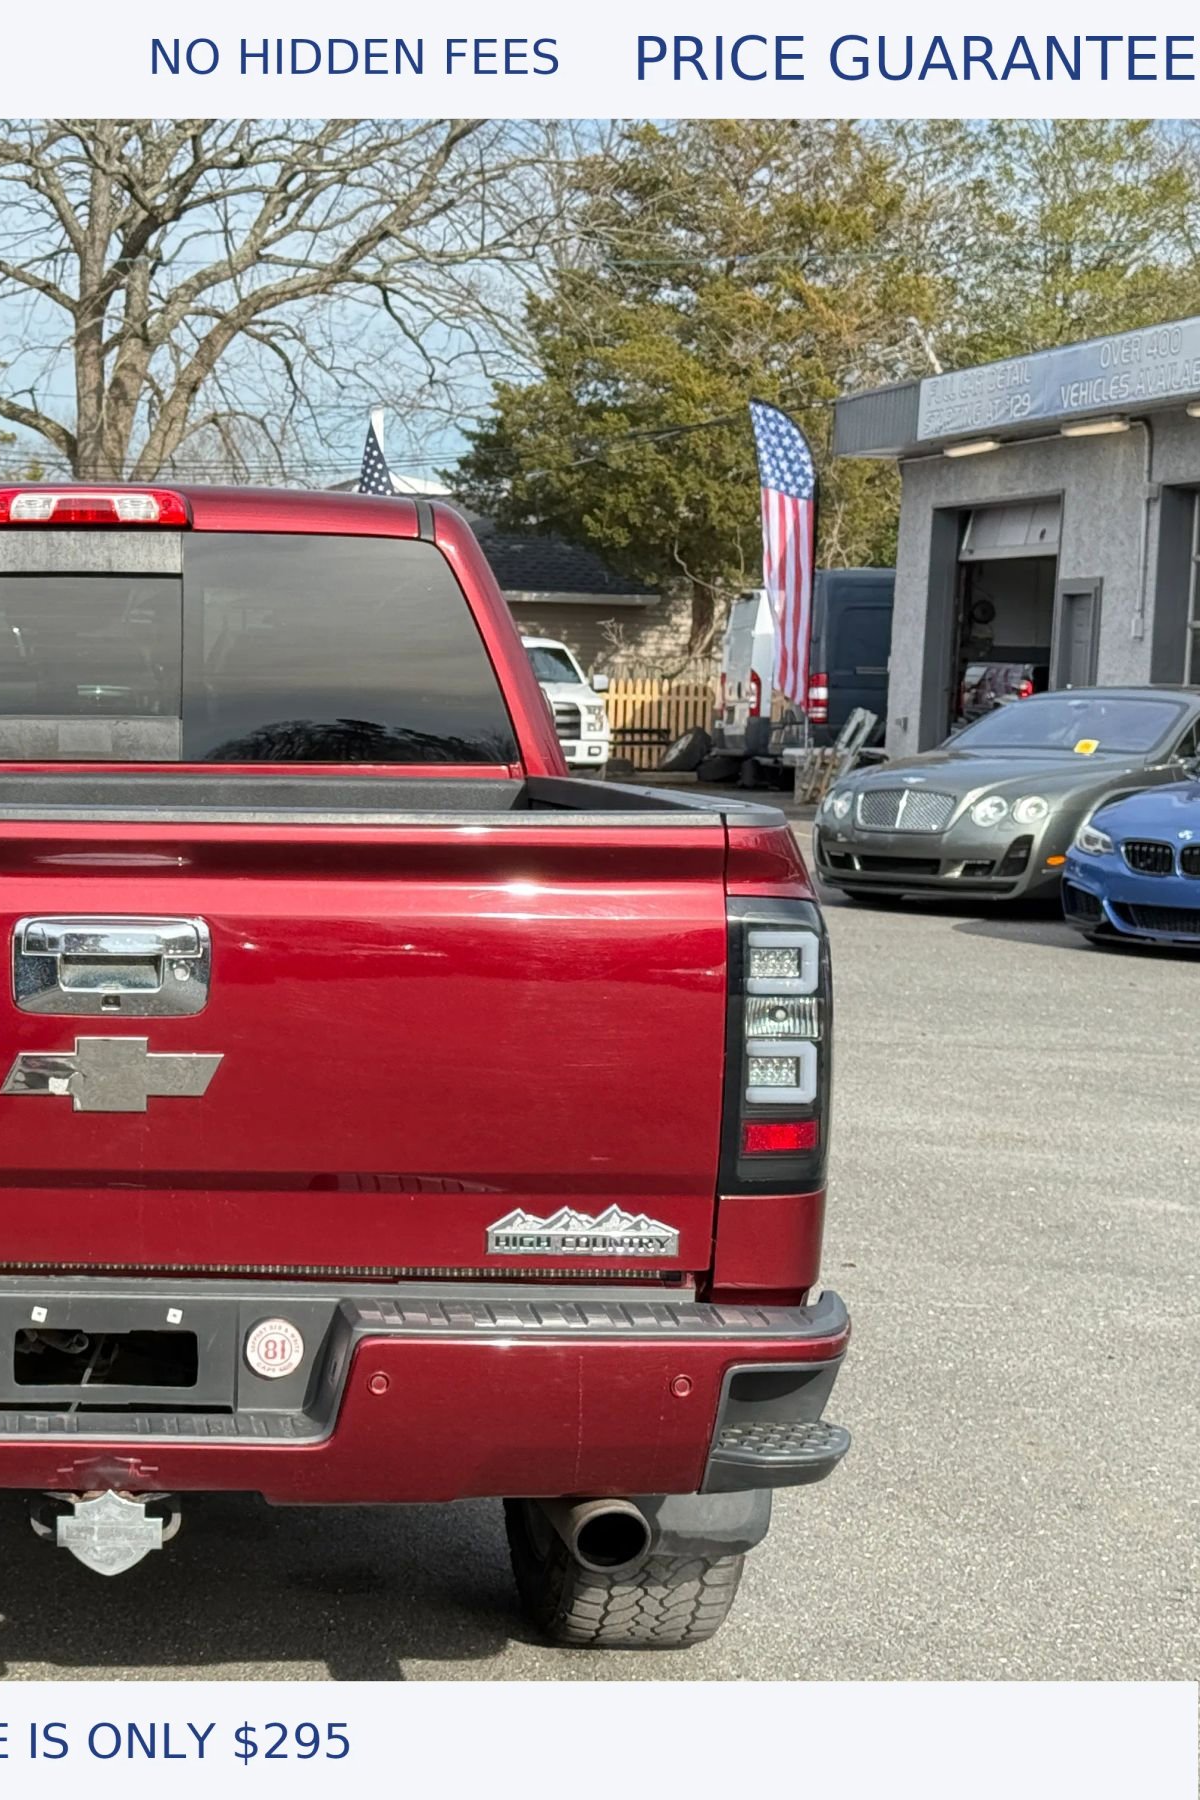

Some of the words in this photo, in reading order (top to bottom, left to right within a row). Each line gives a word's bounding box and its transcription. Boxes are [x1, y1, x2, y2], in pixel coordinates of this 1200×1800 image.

[1100, 336, 1141, 369] OVER
[1146, 327, 1182, 357] 400
[1060, 373, 1129, 409] VEHICLES
[495, 1236, 551, 1250] HIGH
[561, 1236, 669, 1252] COUNTRY
[264, 1339, 286, 1360] 81
